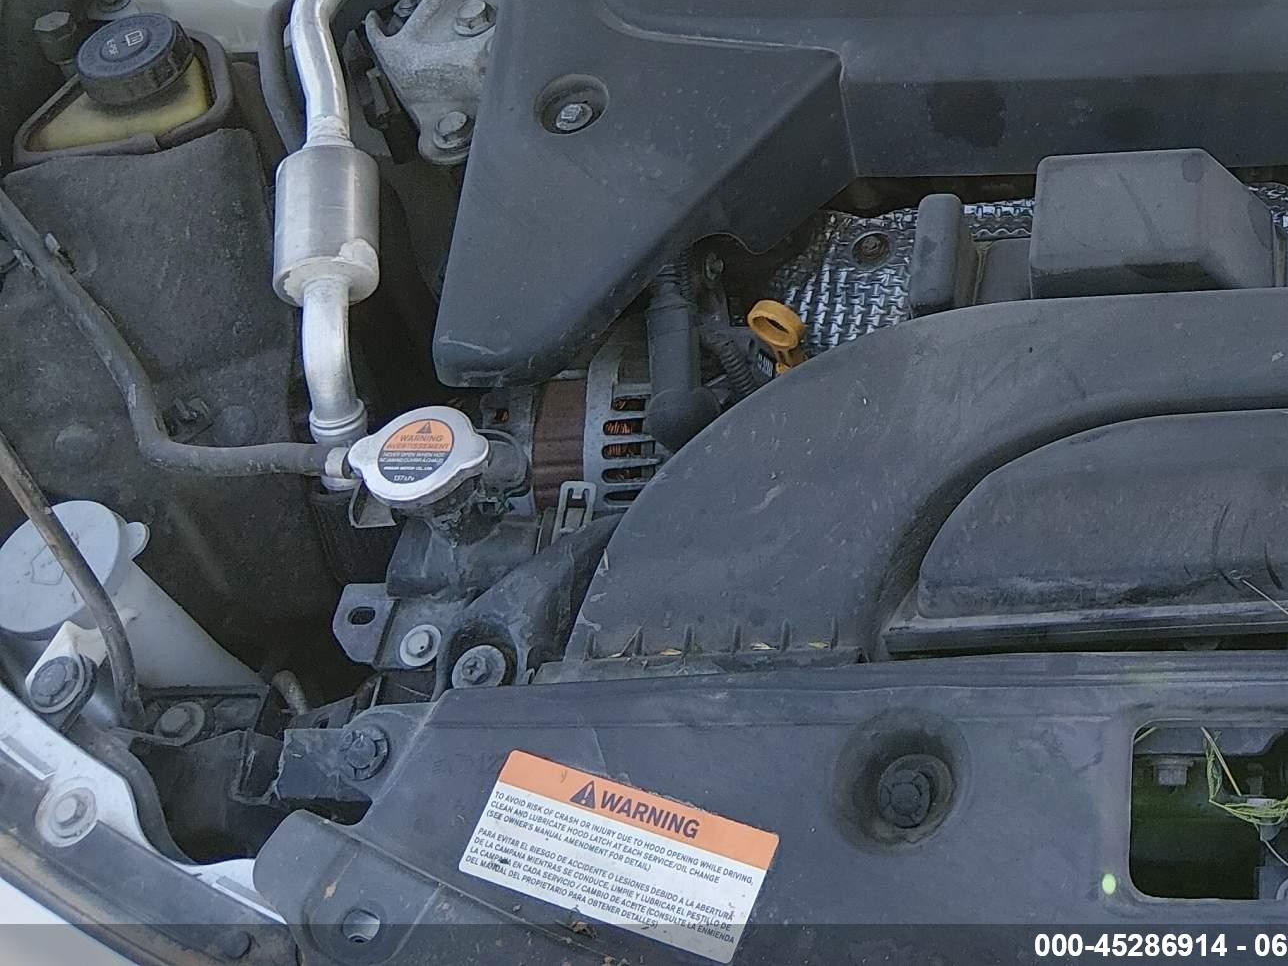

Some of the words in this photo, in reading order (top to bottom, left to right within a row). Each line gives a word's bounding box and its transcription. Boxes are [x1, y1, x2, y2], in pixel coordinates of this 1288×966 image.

[400, 434, 443, 442] WARNING
[490, 801, 513, 813] CLEAN
[513, 809, 528, 818] AND
[529, 814, 566, 831] LUBRICATE
[567, 827, 589, 839] HOOD
[589, 834, 612, 847] LATCH
[613, 842, 622, 850] AT
[623, 846, 642, 858] EACH
[643, 853, 688, 873] SERVICE/OIL
[689, 868, 720, 884] CHANGE
[494, 791, 504, 800] TO
[505, 795, 526, 807] AVOID
[526, 802, 543, 813] RISK
[543, 808, 554, 816] OF
[554, 811, 579, 825] CRASH
[580, 820, 591, 829] OR
[591, 824, 616, 837] INJURY
[617, 833, 632, 843] DUE
[633, 839, 643, 847] TO
[643, 842, 666, 855] HOOD
[666, 850, 699, 866] OPENING
[699, 861, 722, 874] WHILE
[503, 815, 534, 831] OWNER'S
[534, 826, 563, 841] MANUAL
[563, 836, 609, 856] AMENDMENT
[609, 851, 624, 862] FOR
[599, 790, 701, 839] WARNING
[465, 855, 480, 865] DEL
[508, 870, 522, 880] DEL
[521, 875, 568, 896] PROPIETARIO
[568, 891, 587, 902] PARA
[587, 897, 621, 914] OBTENER
[470, 846, 479, 854] LA
[512, 861, 522, 869] EN
[522, 865, 542, 876] CADA
[542, 871, 576, 888] SERVICIO
[581, 885, 609, 899] CAMBIO
[610, 895, 620, 904] DE
[621, 899, 646, 913] ACEITE
[647, 908, 686, 927] (CONSULTE
[687, 922, 696, 930] LA
[697, 925, 735, 943] ENMIENDA
[474, 837, 485, 846] DE
[485, 841, 494, 849] LA
[494, 844, 526, 860] CAMPANA
[526, 855, 562, 872] MIENTRAS
[563, 867, 573, 876] SE
[611, 885, 634, 898] LIMPIE
[641, 895, 676, 912] LUBRICAR
[676, 907, 685, 915] EL
[686, 911, 720, 927] PESTILLO
[720, 922, 732, 931] DE
[478, 828, 496, 839] PARA
[497, 834, 520, 847] EVITAR
[520, 842, 529, 850] EL
[529, 846, 556, 860] RIESGO
[557, 855, 567, 864] DE
[568, 859, 607, 877] ACCIDENTE
[607, 872, 614, 880] O
[615, 875, 650, 893] LESIONES
[650, 887, 678, 902] DEBIDO
[685, 899, 695, 908] LA
[695, 903, 734, 921] ABERTURA
